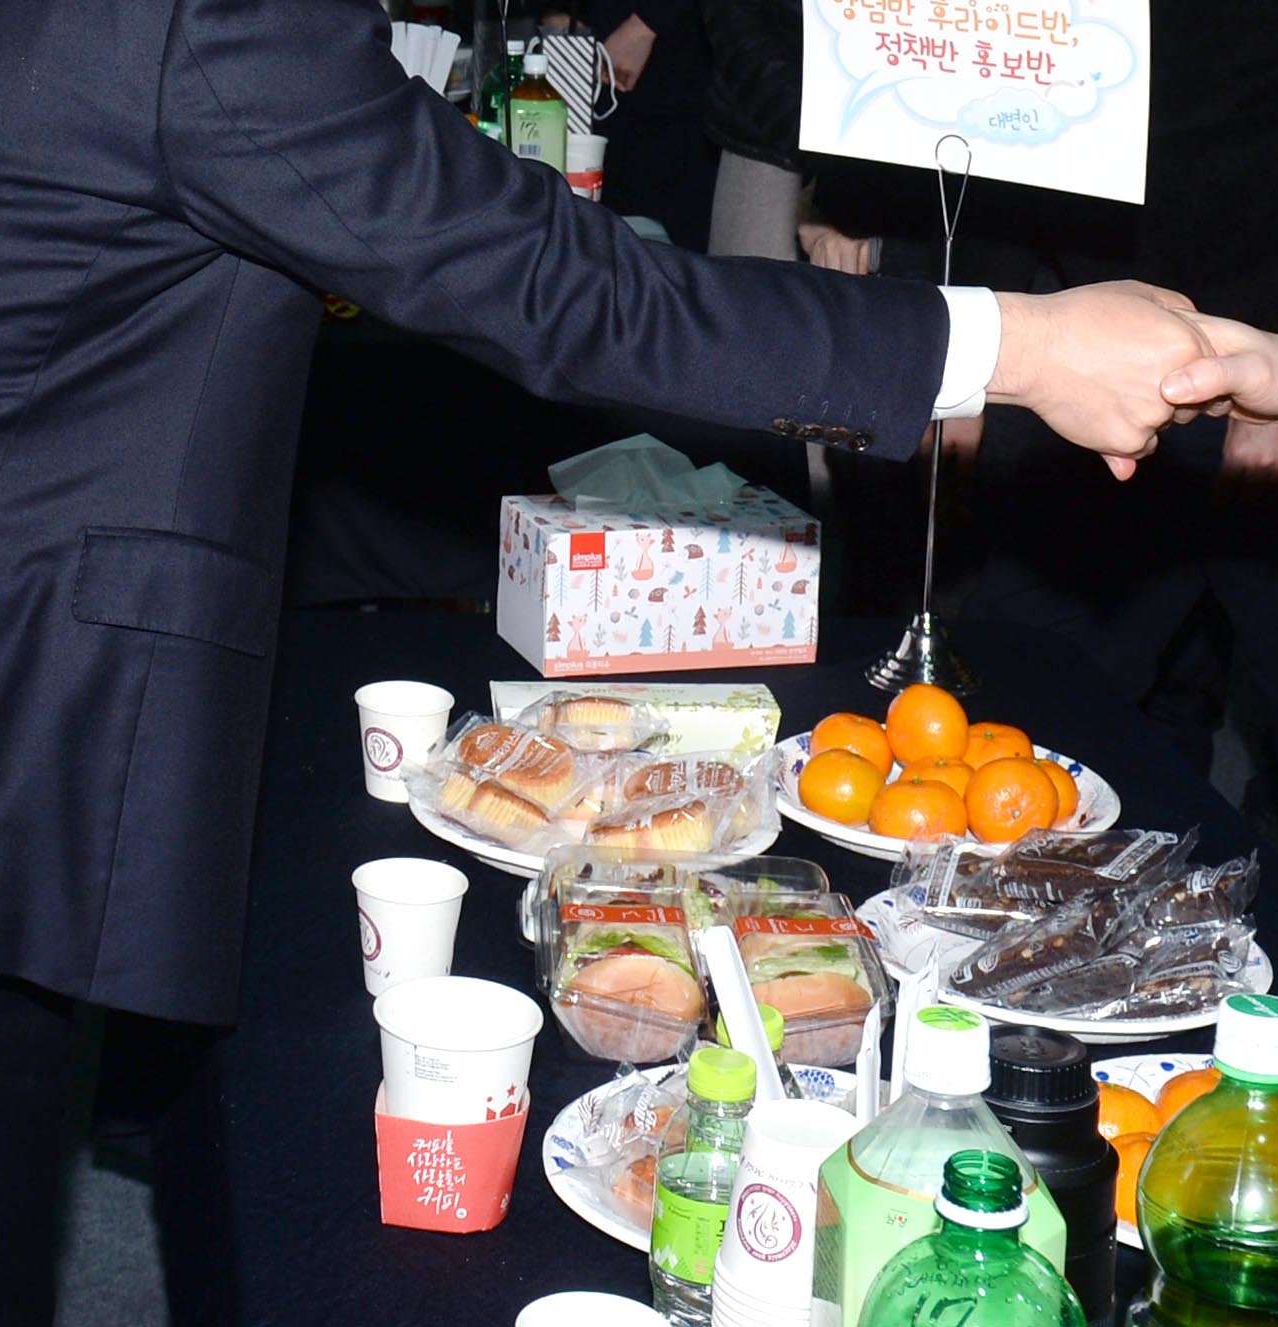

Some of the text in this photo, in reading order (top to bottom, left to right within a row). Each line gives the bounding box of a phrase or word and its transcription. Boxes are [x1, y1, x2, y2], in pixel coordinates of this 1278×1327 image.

[874, 31, 1056, 86] 정책반 홍보반
[988, 108, 1040, 132] 대변인
[413, 1130, 455, 1155] 커피를
[406, 1152, 465, 1170] 사랑하는
[413, 1168, 466, 1191] 사람들의
[417, 1186, 460, 1215] 커피
